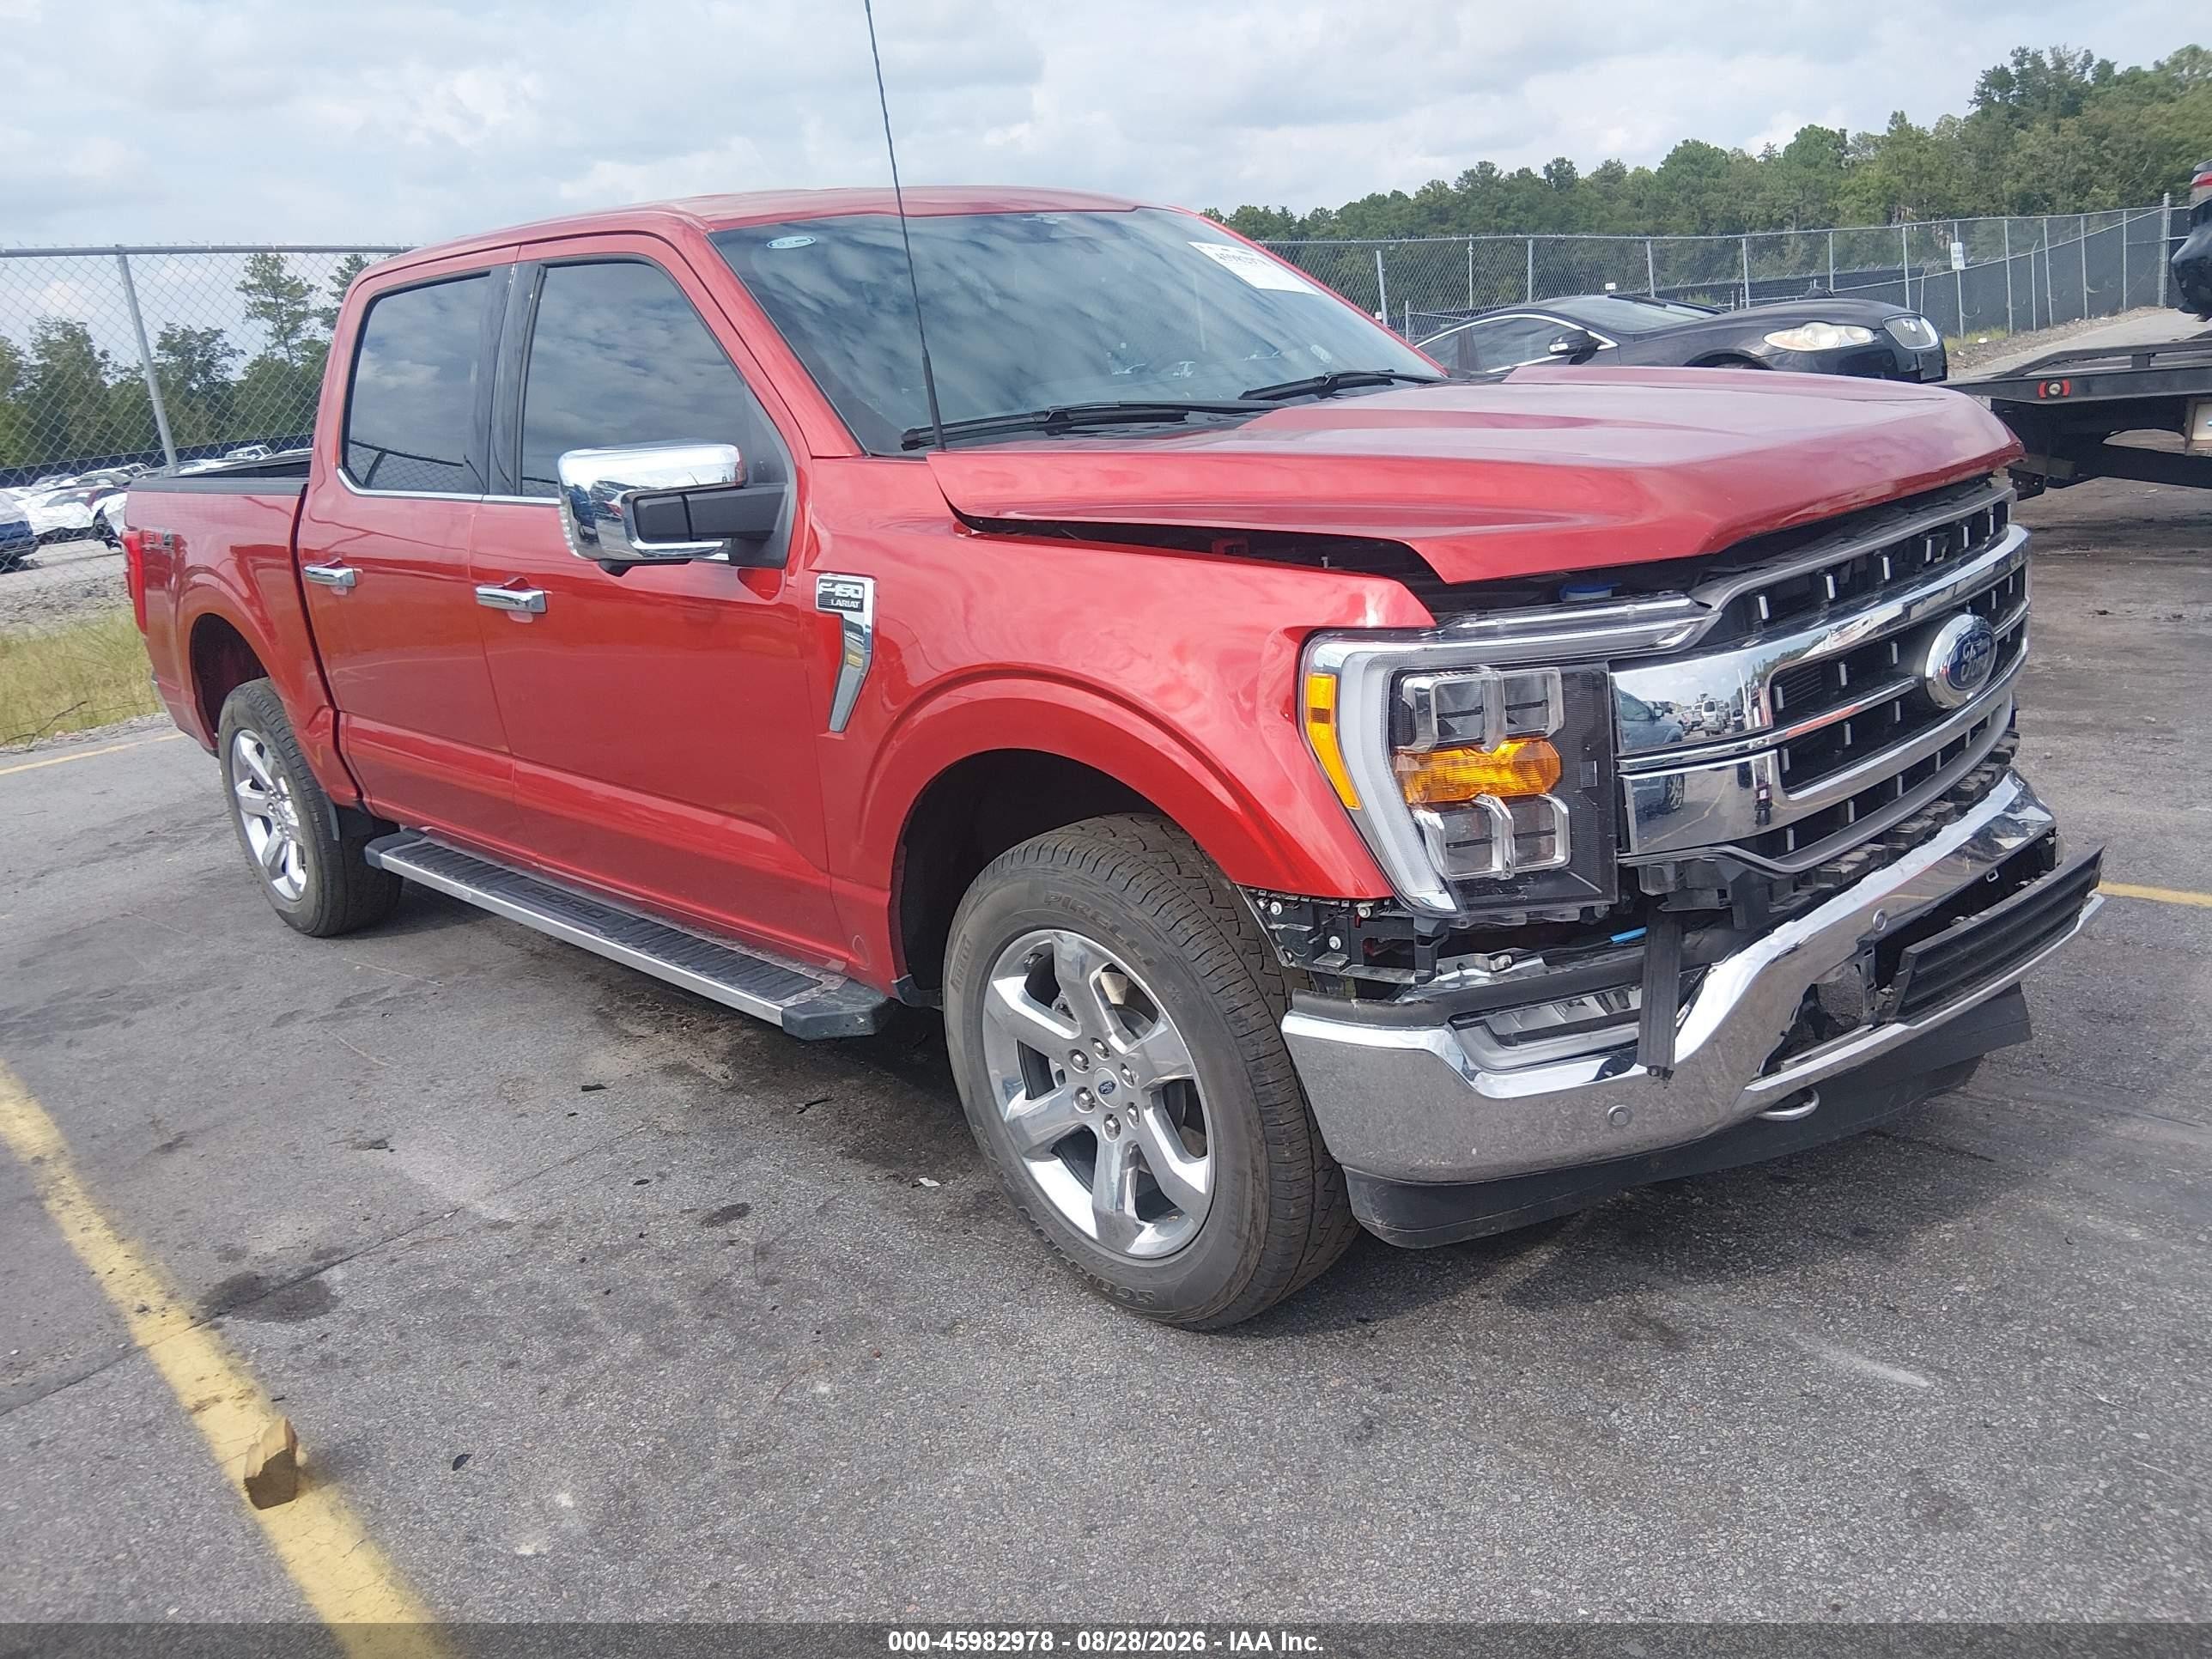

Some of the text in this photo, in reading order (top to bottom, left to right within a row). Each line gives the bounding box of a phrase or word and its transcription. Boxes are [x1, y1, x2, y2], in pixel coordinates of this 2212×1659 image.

[830, 599, 860, 609] LARIAT
[1960, 638, 1991, 683] Ford
[1042, 890, 1158, 968] PIRELLI
